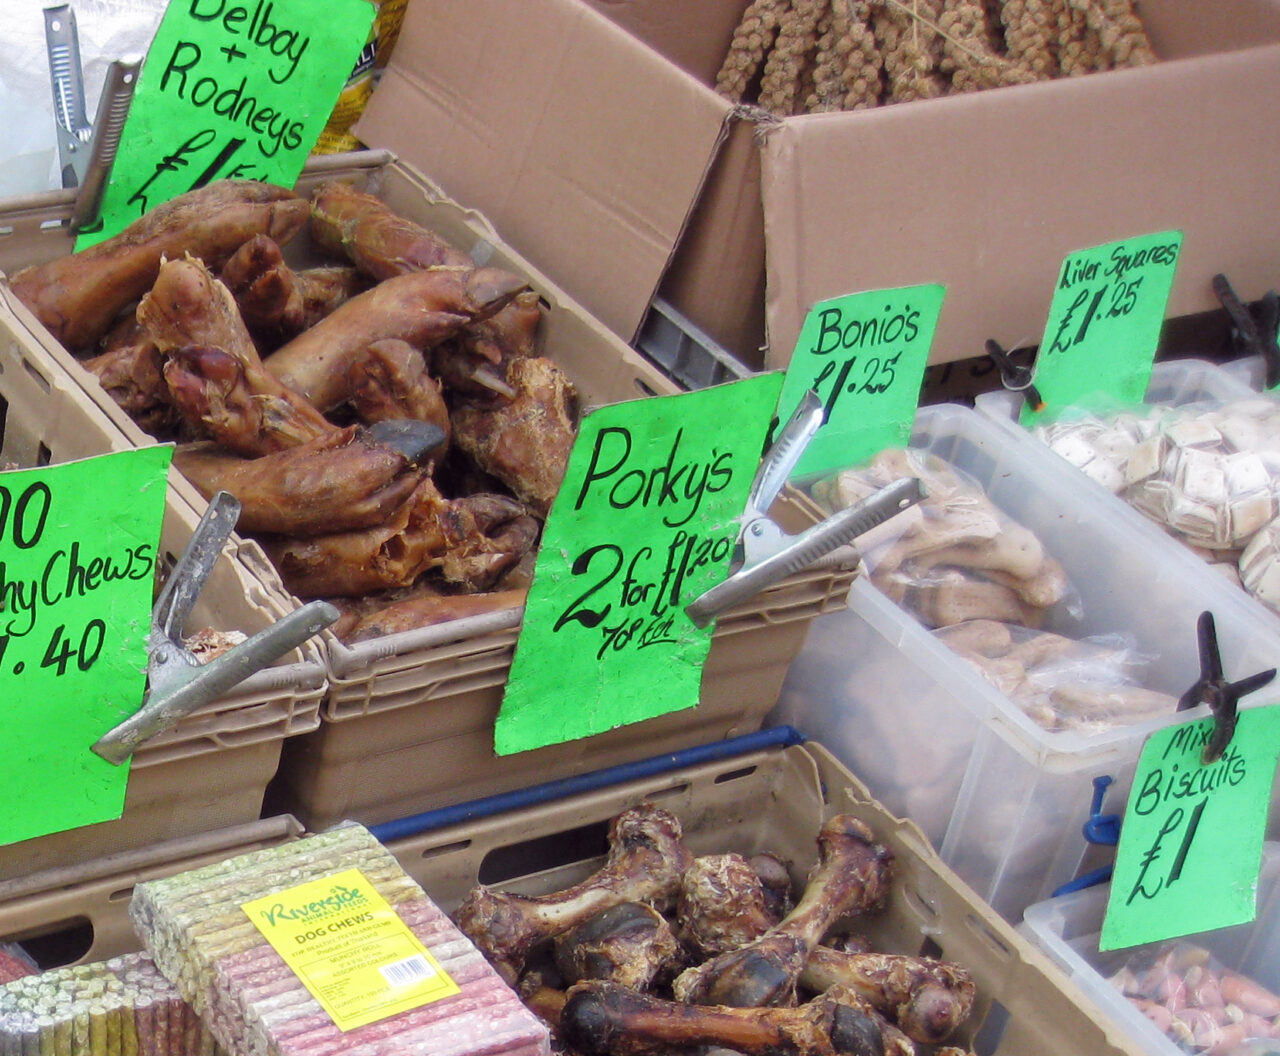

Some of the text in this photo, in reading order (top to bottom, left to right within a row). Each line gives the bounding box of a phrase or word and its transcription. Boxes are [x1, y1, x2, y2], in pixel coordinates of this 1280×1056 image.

[160, 41, 304, 157] Rodneys
[1059, 242, 1178, 289] Liver Squares
[811, 304, 920, 354] Bonio's
[1048, 276, 1144, 355] £1.25
[574, 427, 733, 527] Porky's
[553, 544, 624, 632] 2
[620, 547, 655, 608] for
[1135, 745, 1246, 815] Biscuits
[1126, 797, 1209, 906] £1
[260, 886, 363, 928] Riverside
[294, 911, 374, 944] DOG CHEWS
